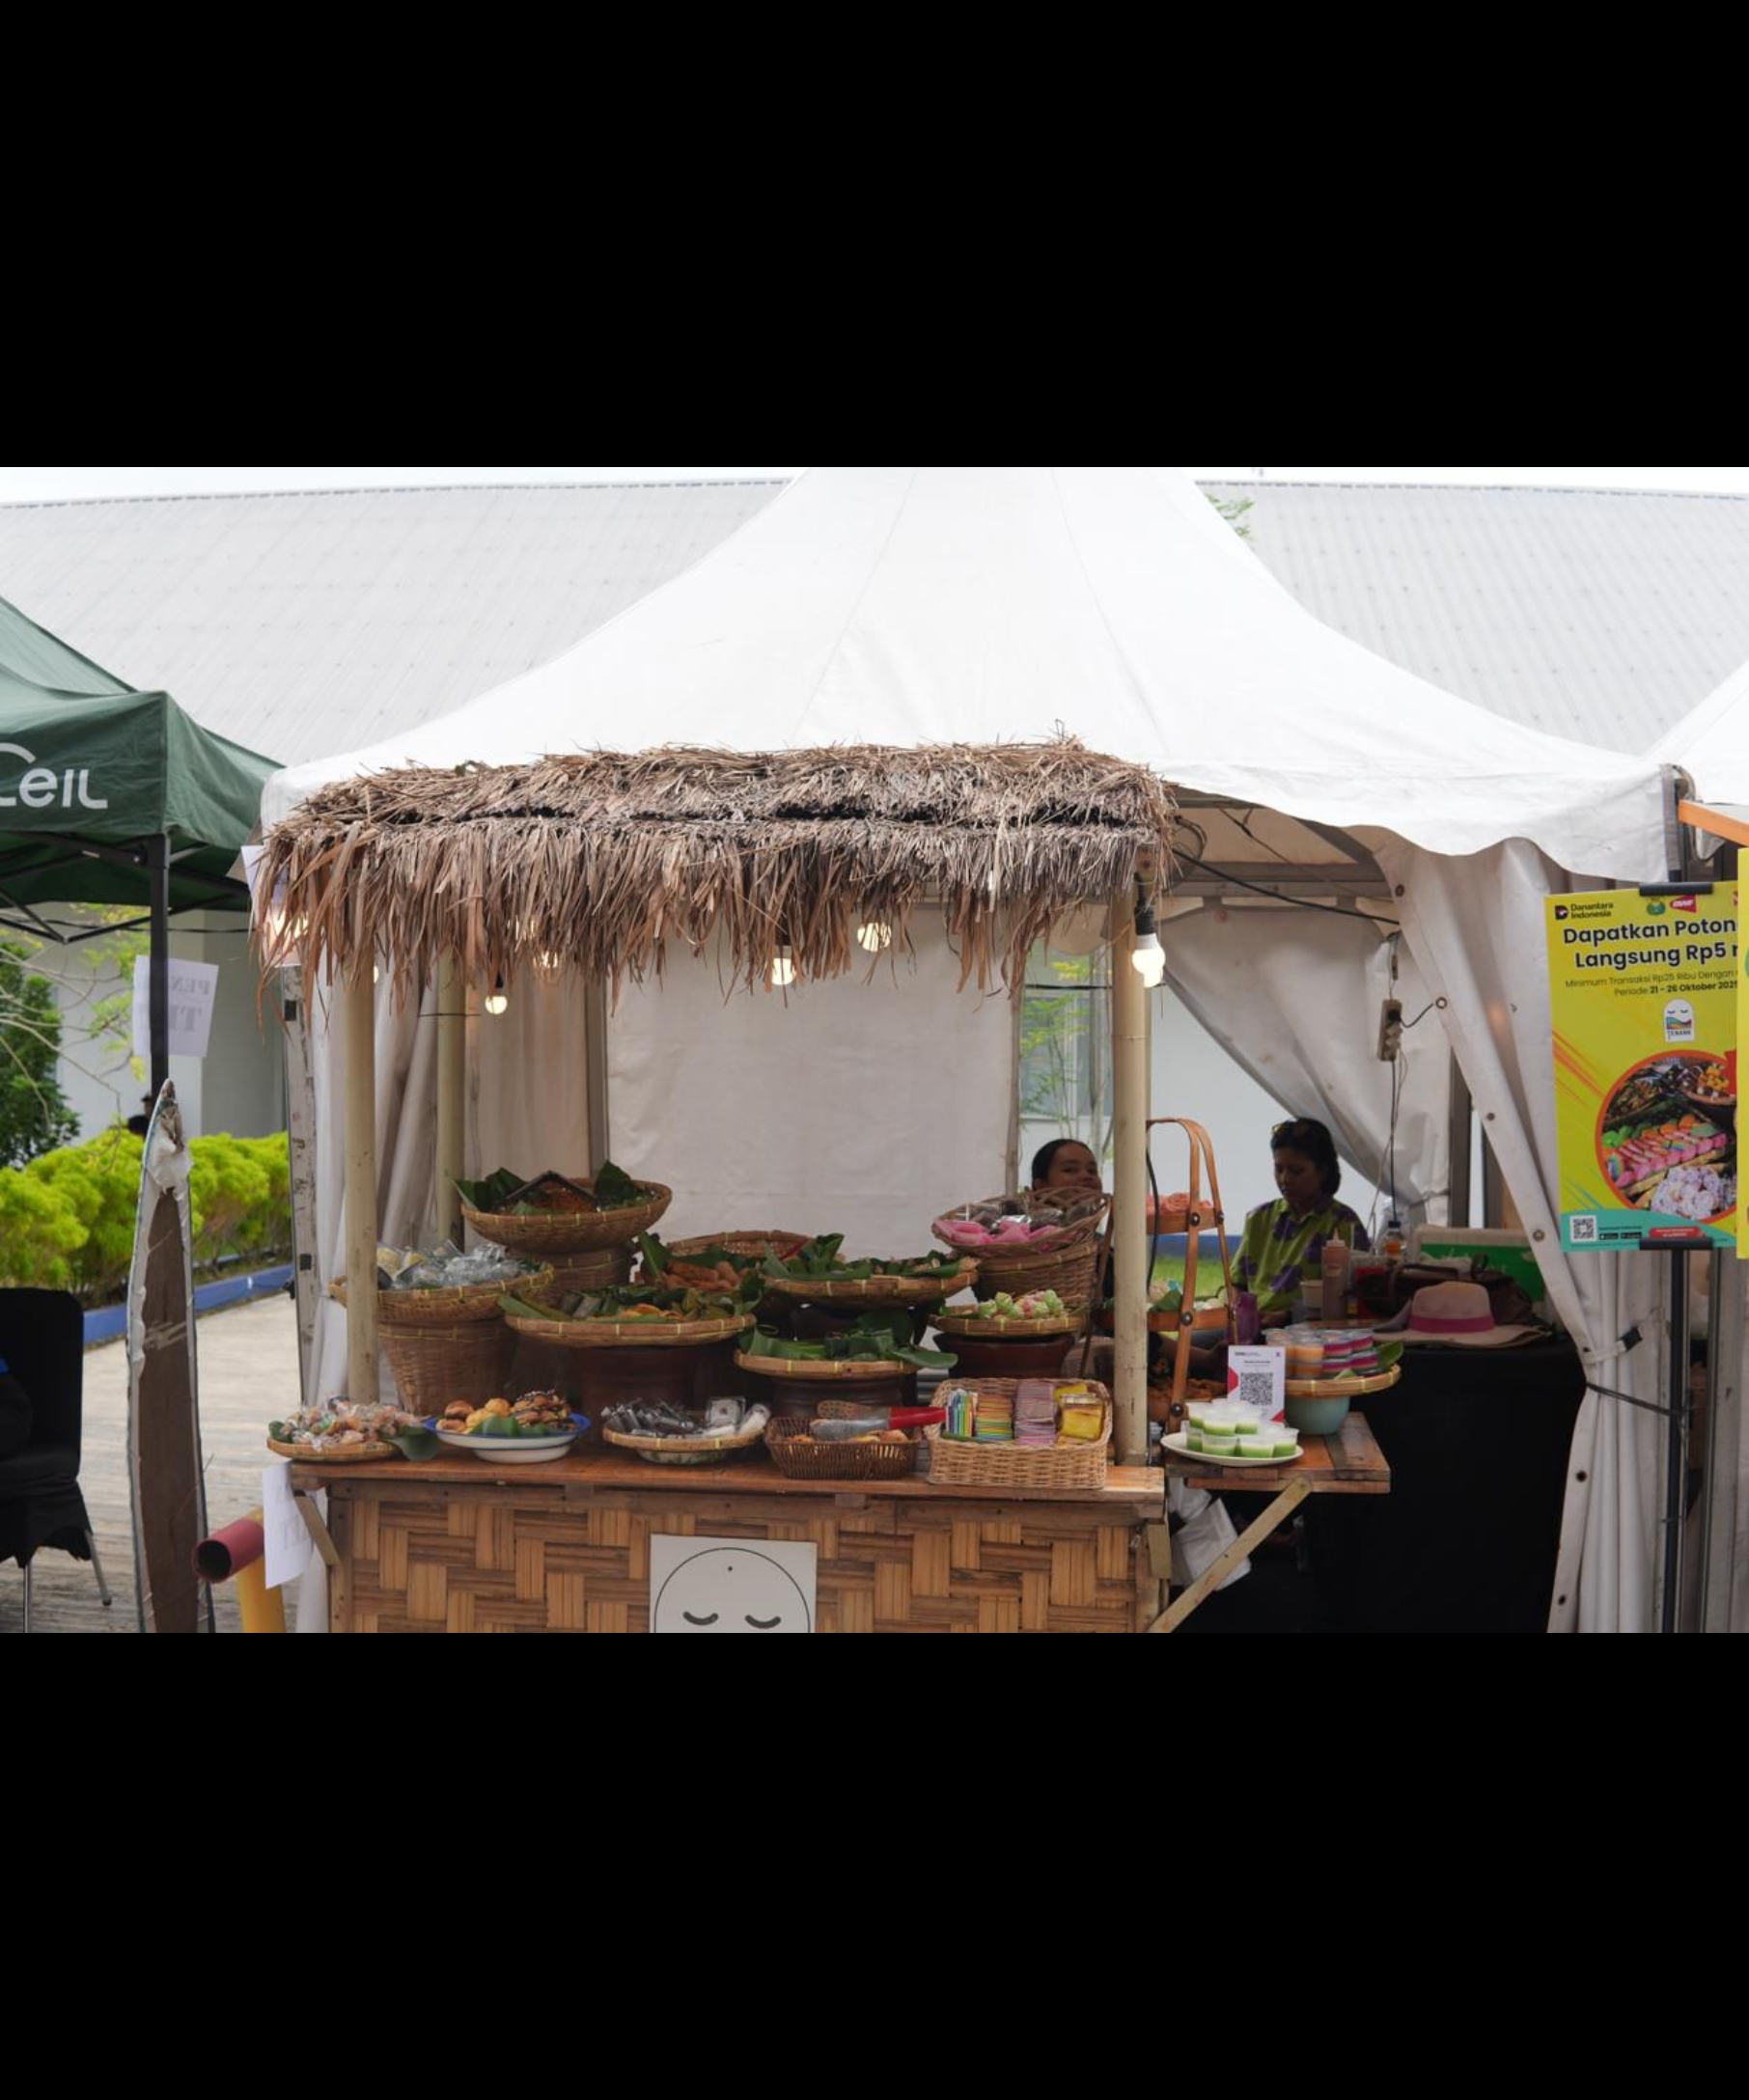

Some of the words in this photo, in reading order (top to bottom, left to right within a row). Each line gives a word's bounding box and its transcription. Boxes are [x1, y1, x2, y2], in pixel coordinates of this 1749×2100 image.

[1570, 901, 1614, 912] Danantara
[1570, 910, 1612, 920] Indonesia
[1564, 923, 1670, 948] Dapatkan
[1675, 918, 1738, 936] Poton
[1575, 947, 1680, 971] Langsung
[1686, 942, 1727, 964] Rp5
[1565, 977, 1608, 988] Minimum
[1609, 974, 1652, 986] Transaksi
[1698, 969, 1734, 981] Dengan
[1614, 985, 1650, 997] Periode
[1650, 984, 1659, 994] 21
[1680, 981, 1717, 992] Oktober
